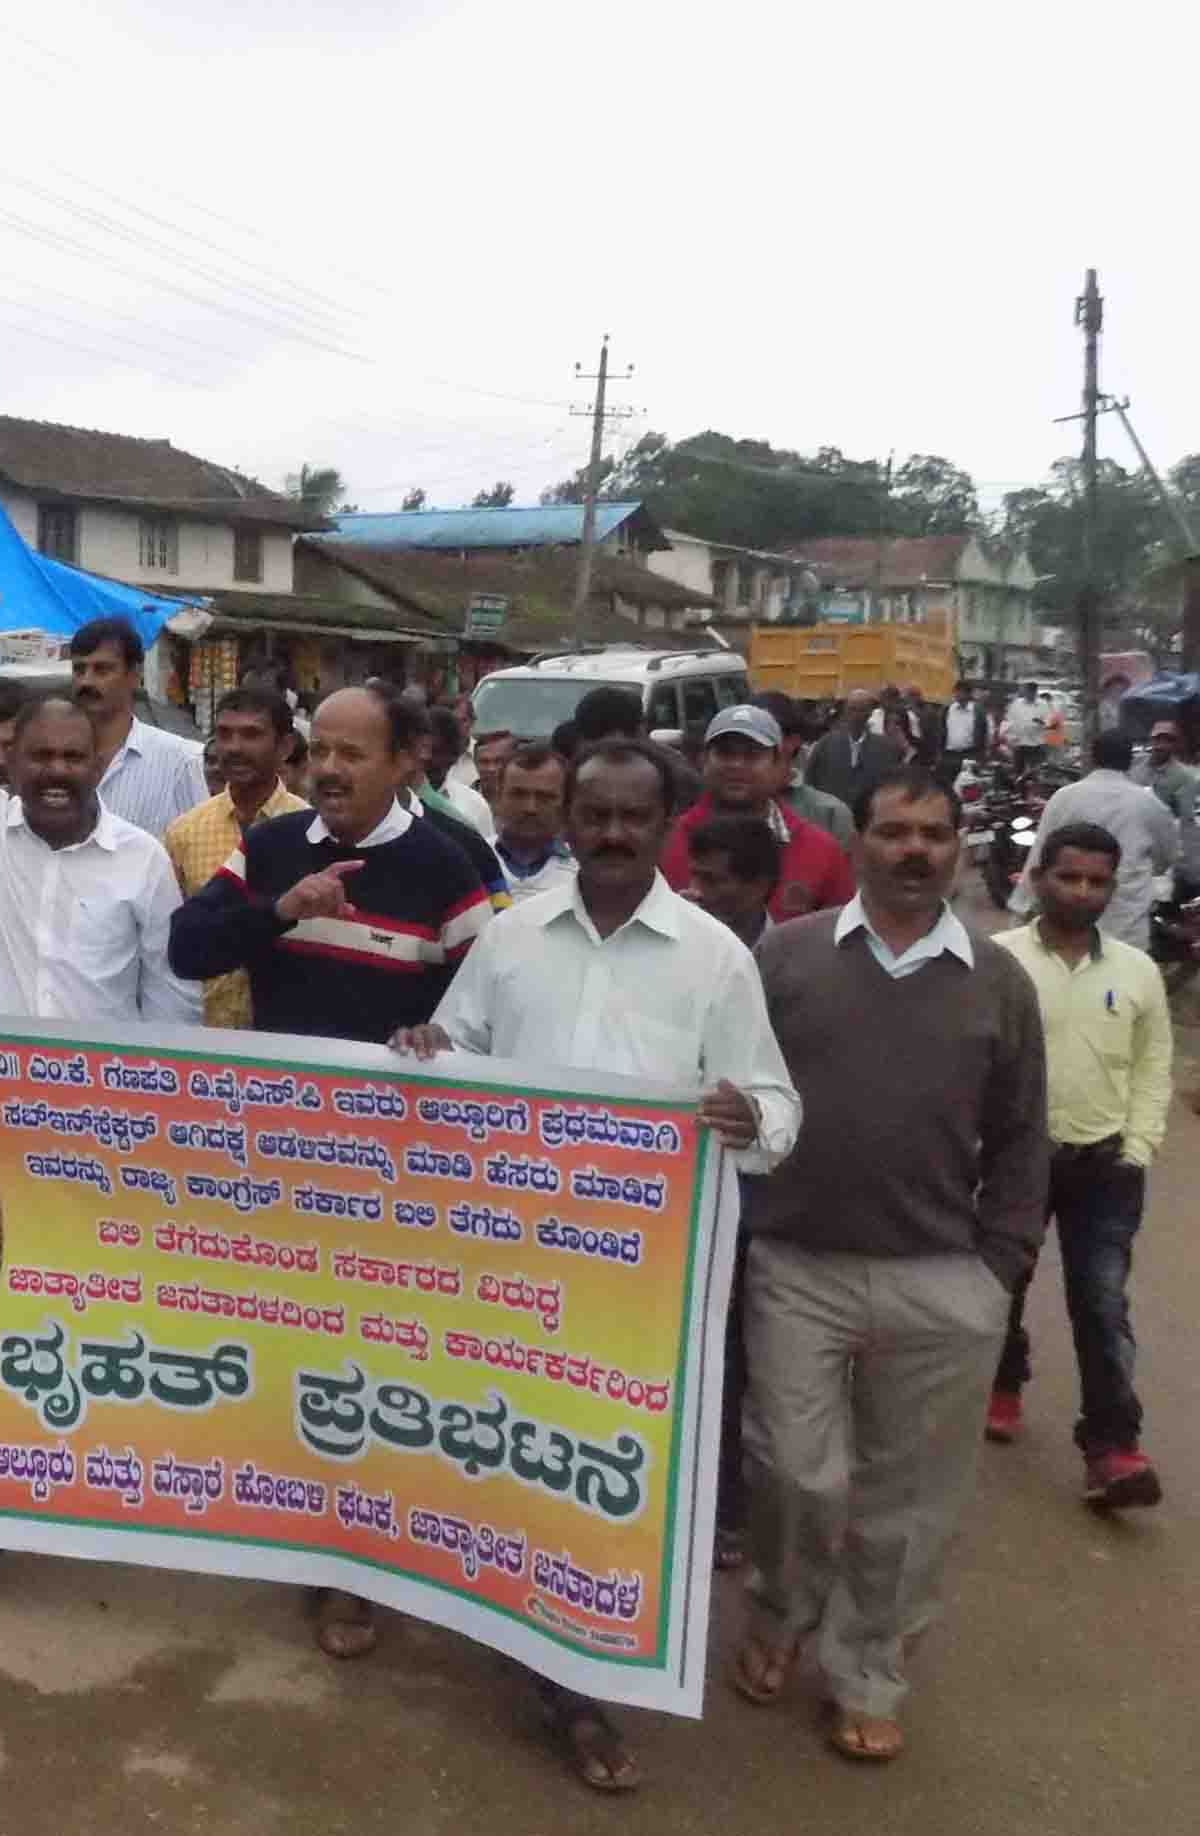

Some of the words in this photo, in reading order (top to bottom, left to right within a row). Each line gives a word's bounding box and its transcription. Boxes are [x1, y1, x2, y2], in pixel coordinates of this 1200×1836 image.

[103, 1062, 177, 1092] ಗಣಪತಿ
[334, 1087, 404, 1117] ಇವರು
[420, 1099, 527, 1139] ಆಲ್ದೂರಿಗೆ
[542, 1109, 678, 1151] ಪ್ರಥಮವಾಗಿ
[27, 1153, 111, 1193] ಇವರನ್ನು
[121, 1167, 176, 1205] ರಾಜ್ಯ
[186, 1175, 280, 1211] ಕಾಂಗ್ರೆಸ್
[295, 1186, 380, 1219] ಸರ್ಕಾರ
[395, 1203, 436, 1226] ಬಲಿ
[450, 1203, 521, 1240] ತೆಗೆದು
[407, 1149, 472, 1178] ಮಾಡಿ
[487, 1153, 558, 1191] ಹೆಸರು
[573, 1167, 664, 1208] ಮಾಡಿದ
[100, 1221, 140, 1246] ಬಲಿ
[155, 1223, 319, 1273] ತೆಗೆದುಕೊಂಡ
[334, 1252, 460, 1296] ಸರ್ಕಾರದ
[9, 1269, 142, 1312] ಜಾತ್ಯಾತೀತ
[157, 1284, 345, 1334] ಜನತಾದಳದಿಂದ
[360, 1313, 429, 1361] ಮತ್ತು
[445, 1332, 670, 1411] ಕಾರ್ಯಕರ್ತರಿಂದ
[1, 1321, 249, 1427] ಭೃಹತ್
[300, 1364, 644, 1517] ಪ್ರತಿಭಟನೆ
[87, 1452, 141, 1502] ಮತ್ತು
[235, 1464, 325, 1513] ಹೋಬಳಿ
[411, 1511, 524, 1577] ಜಾತ್ಯಾತೀತ
[536, 1554, 640, 1618] ಜನತಾದಳ
